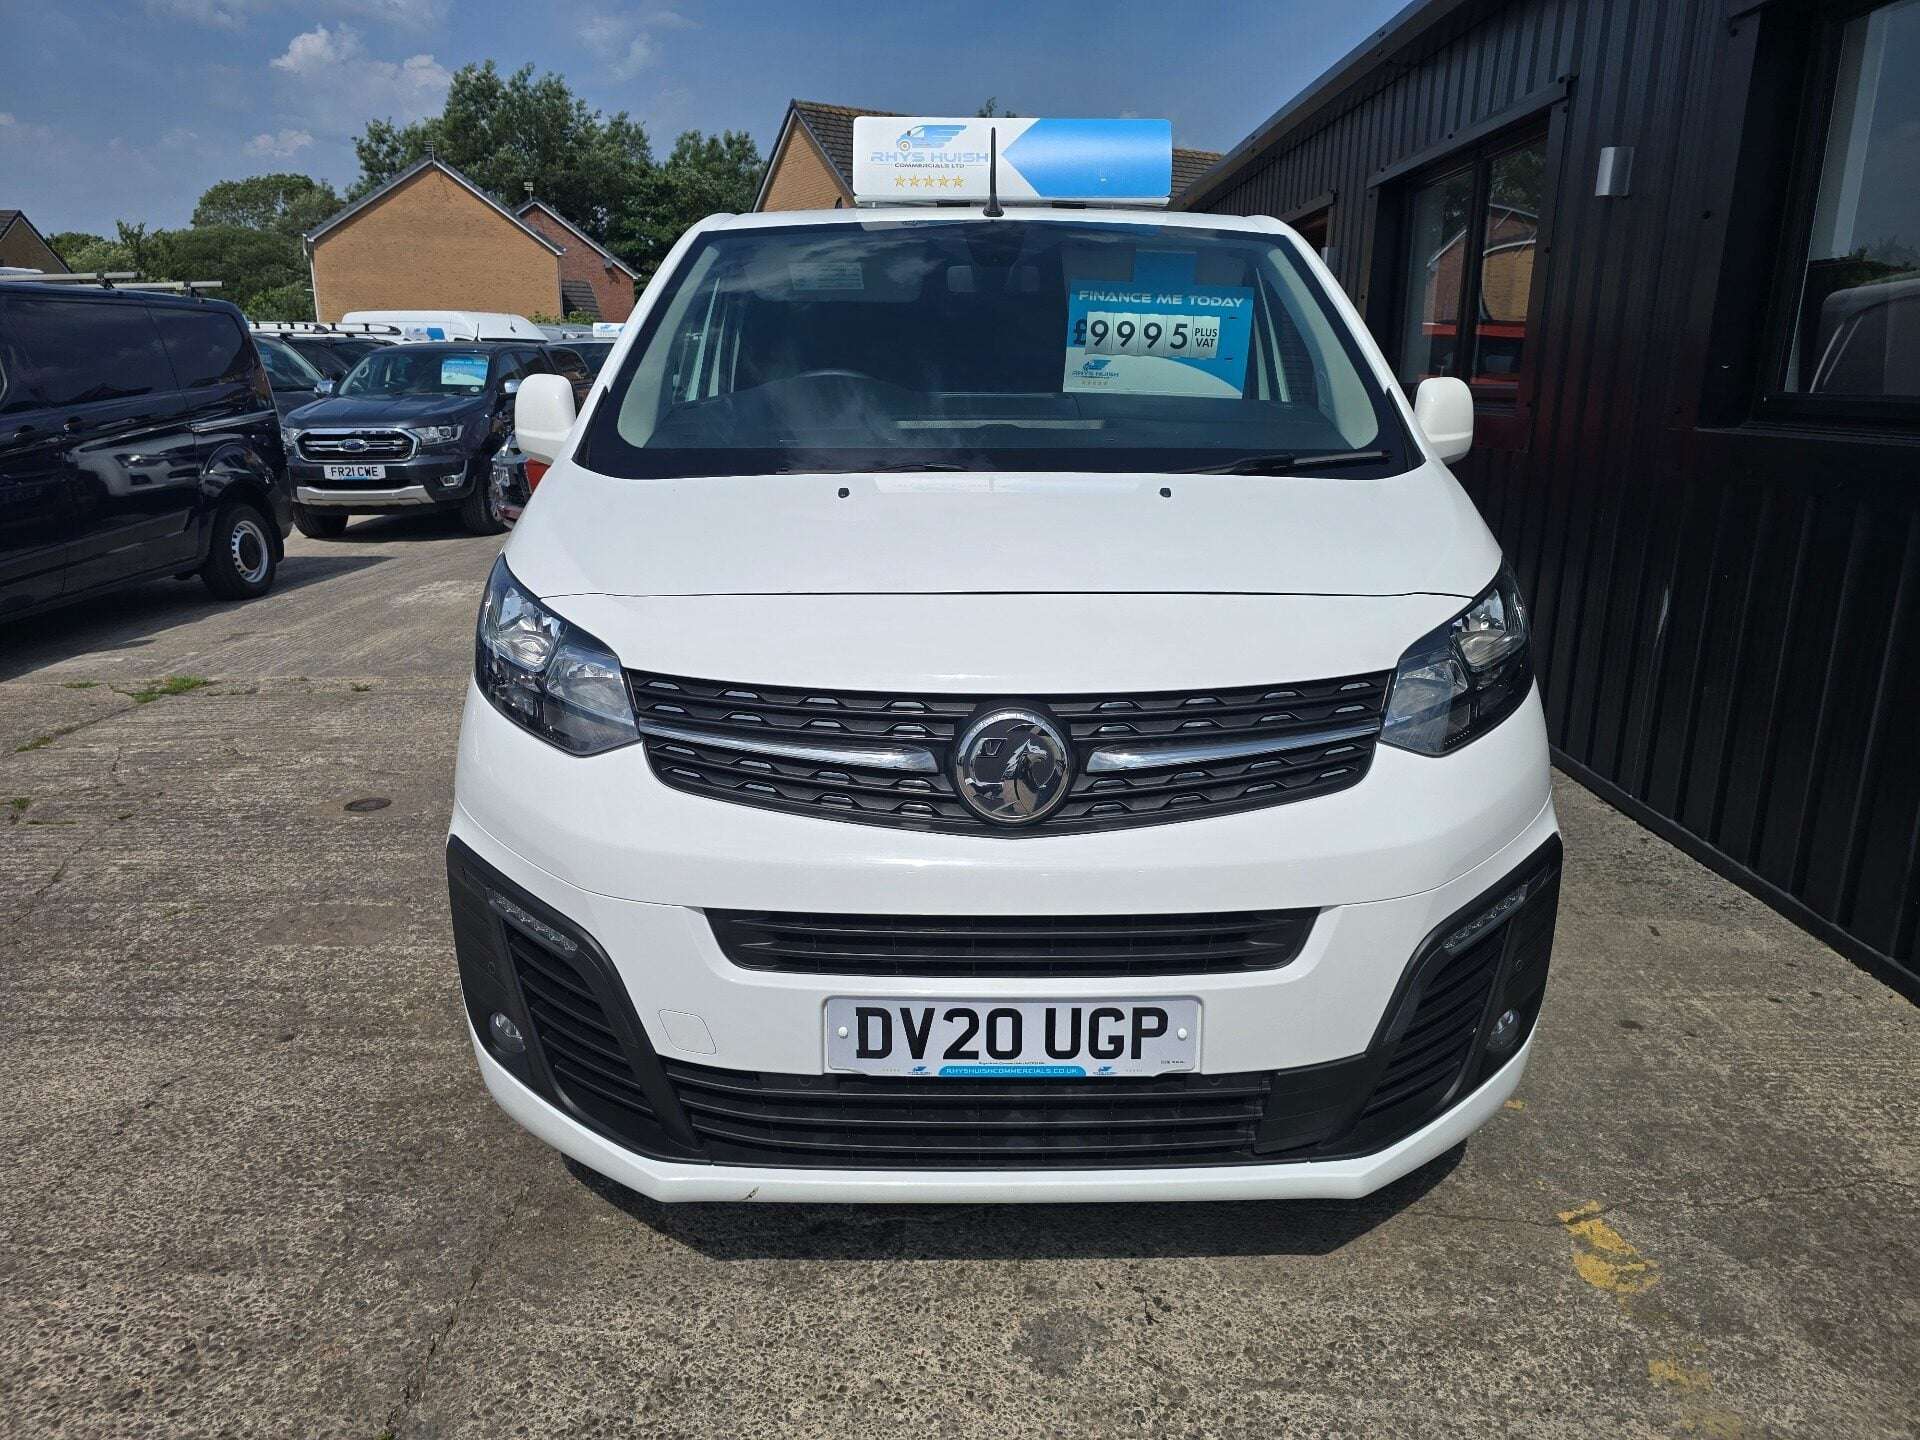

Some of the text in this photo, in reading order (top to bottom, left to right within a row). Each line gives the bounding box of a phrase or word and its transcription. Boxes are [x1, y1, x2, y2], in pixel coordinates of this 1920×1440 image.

[870, 151, 989, 163] RHYS HUISH
[1078, 290, 1244, 308] FINANCE ME TODAY
[1194, 327, 1218, 338] PLUS
[1195, 338, 1216, 348] VAT
[330, 466, 379, 477] FR21 CWE
[855, 1006, 1169, 1060] DV20 UGP
